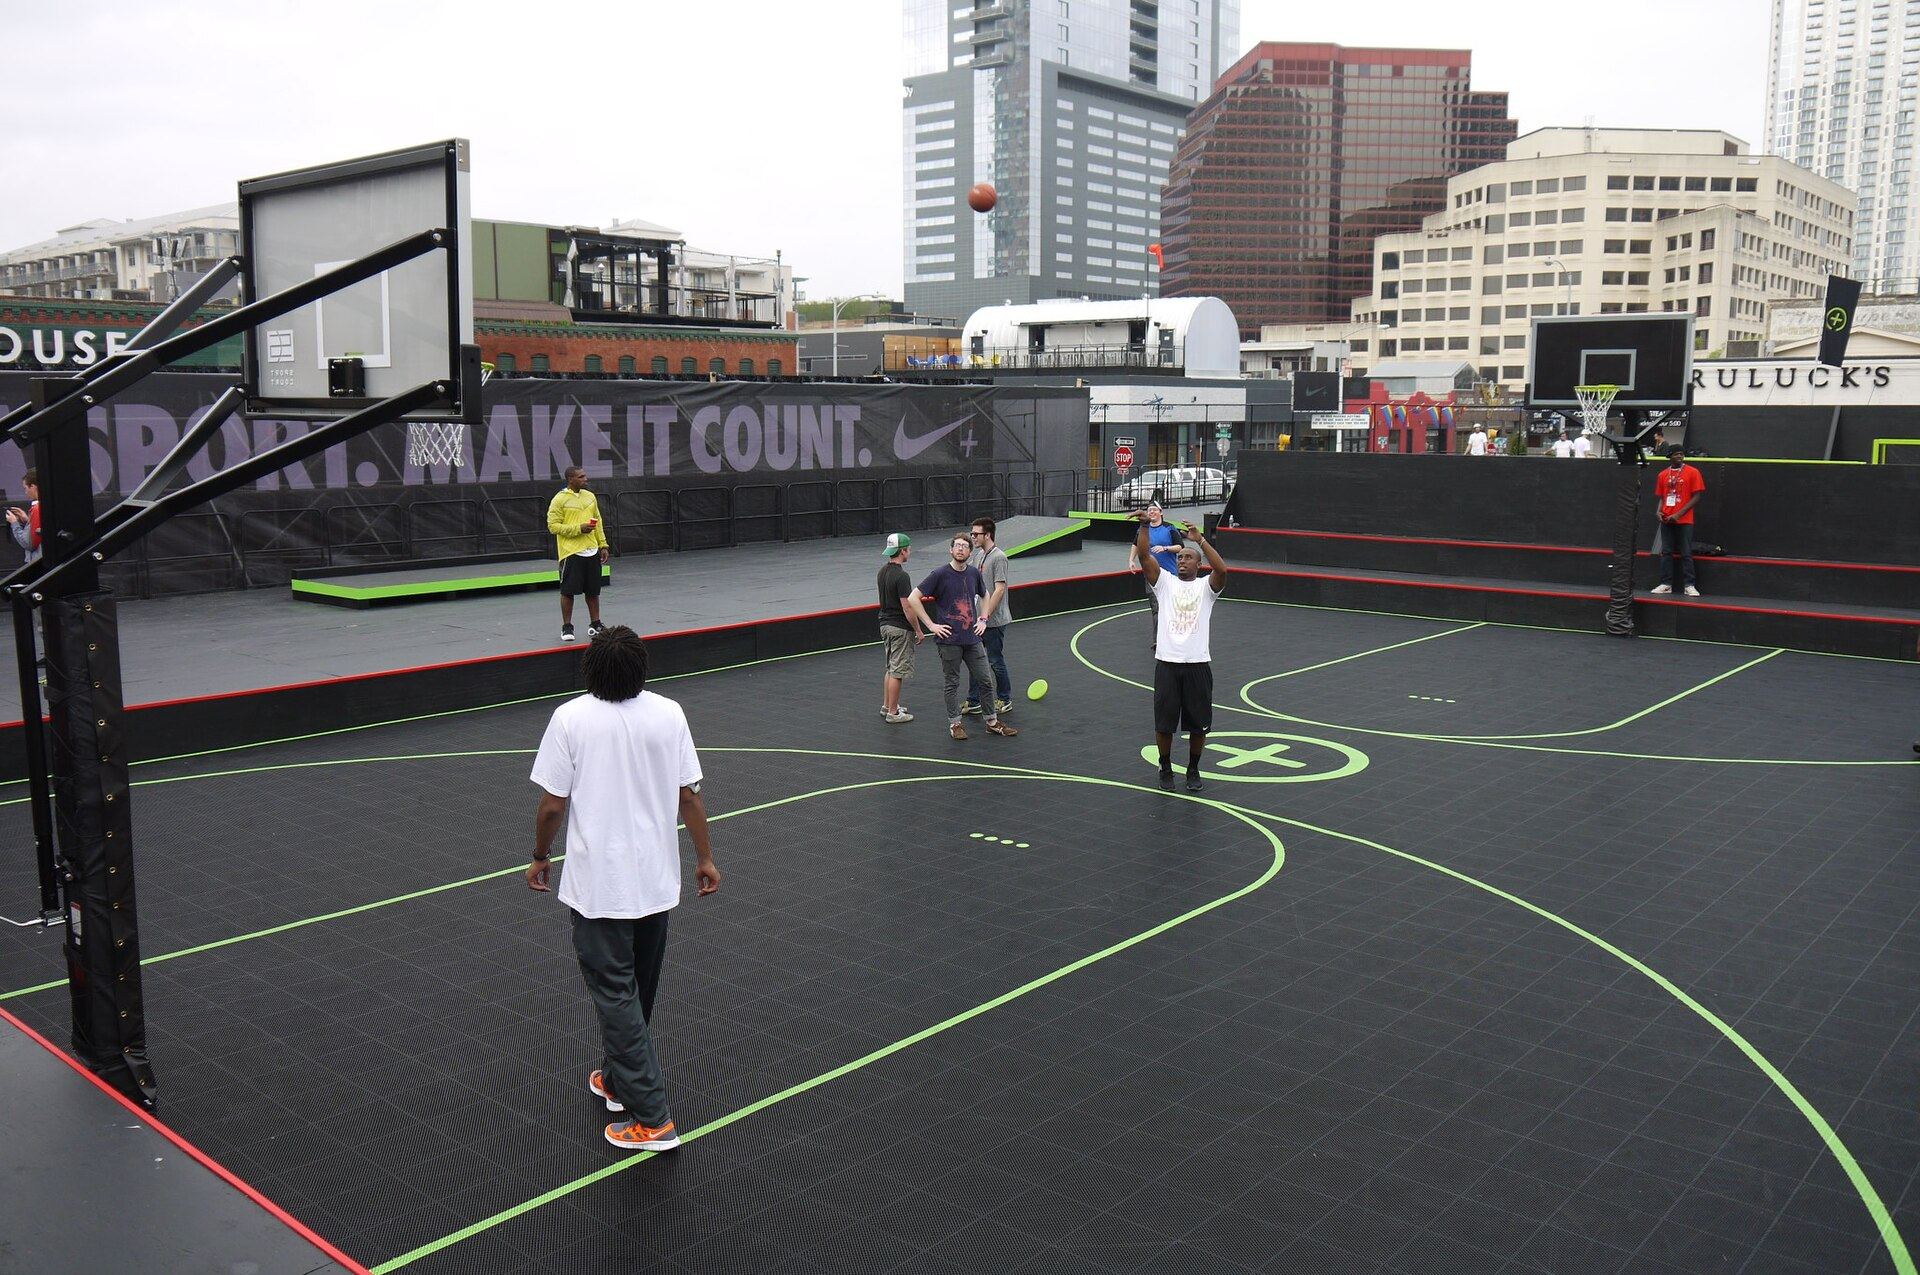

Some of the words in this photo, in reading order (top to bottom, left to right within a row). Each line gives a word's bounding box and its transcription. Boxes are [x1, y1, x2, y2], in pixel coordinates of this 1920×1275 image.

[403, 405, 613, 485] MAKE
[627, 405, 677, 477] IT
[690, 405, 872, 473] COUNT.
[1116, 453, 1131, 463] STOP
